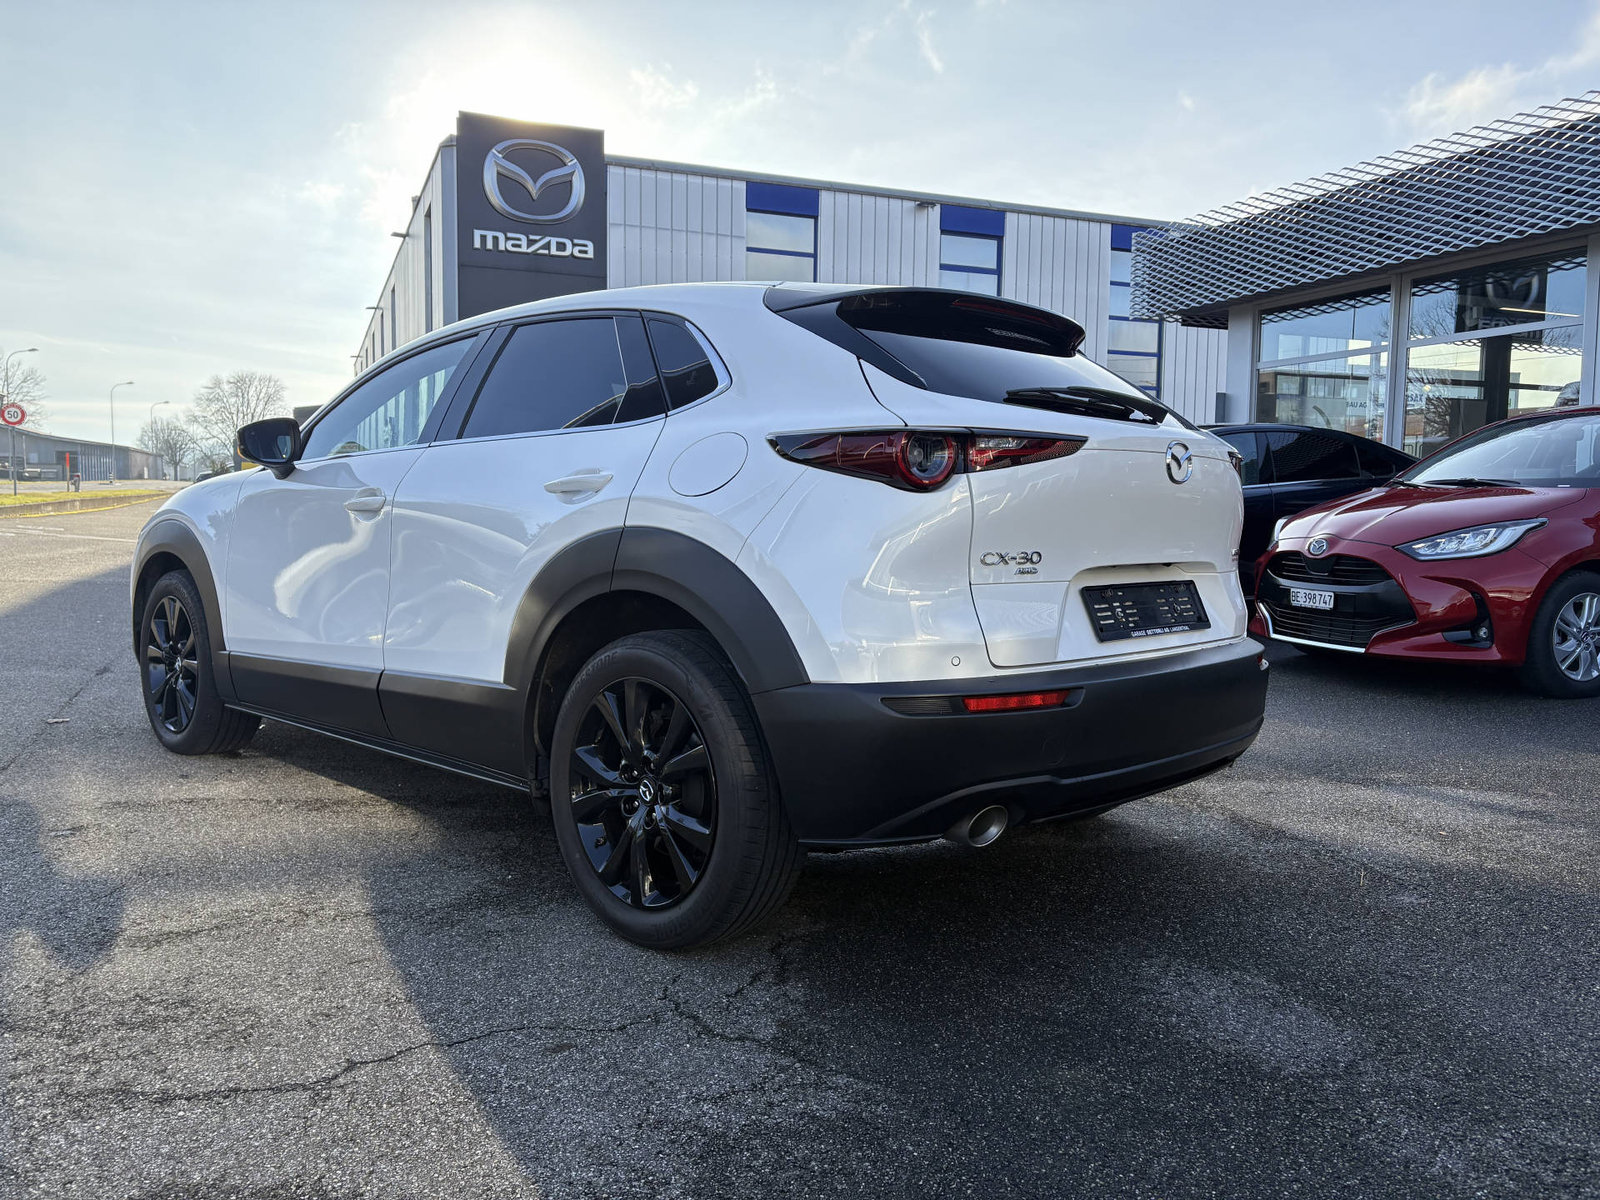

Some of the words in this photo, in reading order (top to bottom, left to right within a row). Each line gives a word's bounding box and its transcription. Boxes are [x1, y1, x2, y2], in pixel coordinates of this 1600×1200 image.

[473, 228, 594, 259] mazda
[7, 410, 19, 419] 50
[979, 551, 1042, 567] CX-30
[1131, 629, 1147, 637] GARAGE
